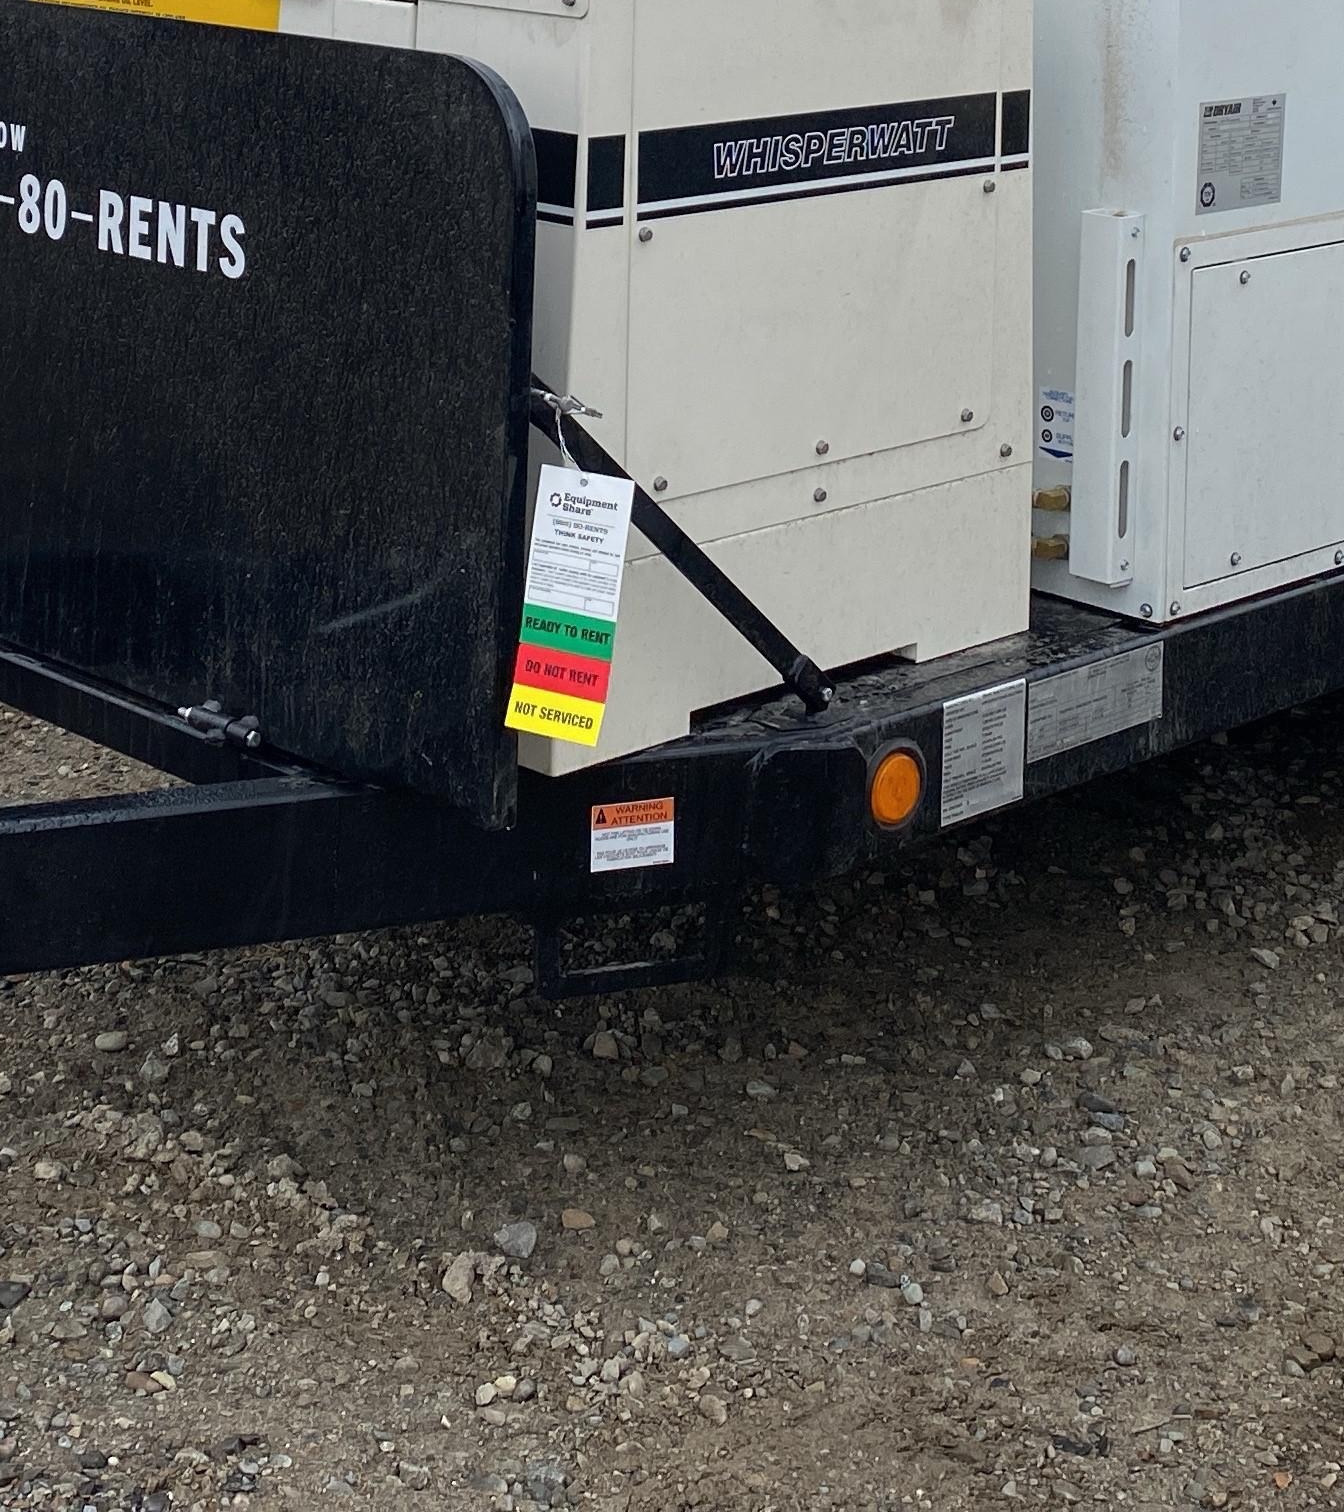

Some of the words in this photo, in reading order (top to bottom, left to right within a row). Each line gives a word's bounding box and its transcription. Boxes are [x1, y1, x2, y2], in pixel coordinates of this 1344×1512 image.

[713, 116, 956, 179] WHISPERWATT
[562, 502, 592, 517] Share
[563, 492, 618, 512] Equipment
[578, 532, 605, 545] SAFETY
[525, 616, 562, 635] READY
[564, 624, 578, 638] TO
[581, 628, 611, 645] RENT
[525, 659, 541, 674] DO
[544, 663, 568, 680] NOT
[569, 669, 600, 687] RENT
[514, 700, 538, 717] NOT
[539, 706, 594, 730] SERVICED
[616, 800, 664, 815] WARNING
[610, 811, 668, 826] ATTENTION
